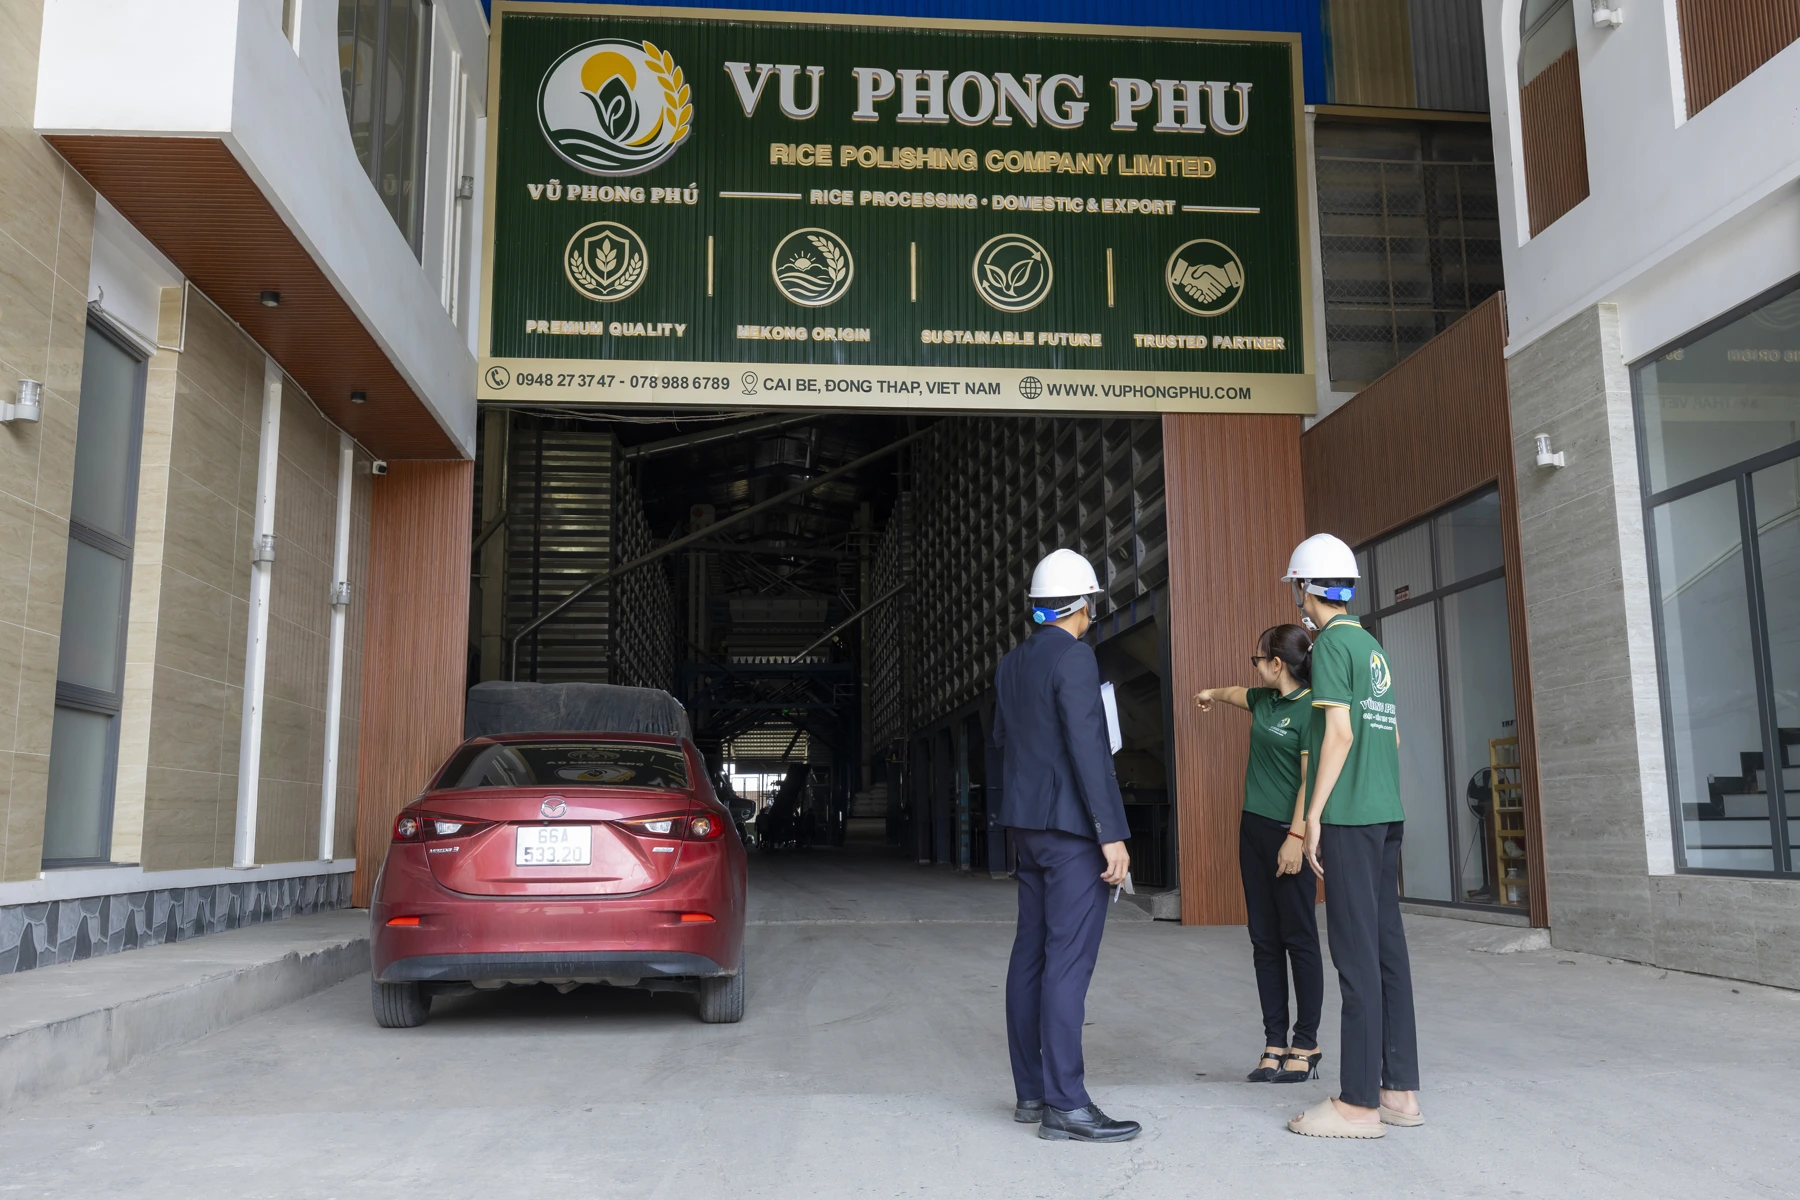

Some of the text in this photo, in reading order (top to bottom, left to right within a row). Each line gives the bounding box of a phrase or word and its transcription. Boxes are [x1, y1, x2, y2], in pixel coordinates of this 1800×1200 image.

[723, 61, 1253, 136] VU PHONG PHU
[770, 143, 1217, 178] RICE POLISHING COMPANY LIMITED
[527, 178, 699, 205] VŨ PHONG PHÚ
[810, 189, 1176, 215] RICE PROCESSING DOMESTIC & EXPORT
[525, 320, 688, 337] PREMIUM QUALITY
[736, 325, 871, 342] MEKONG ORIGIN
[920, 329, 1102, 347] SUSTAINABLE FUTURE
[1133, 333, 1285, 351] TRUSTED PARTNER
[516, 372, 553, 386] 0948
[630, 375, 658, 388] 078
[661, 376, 689, 389] 988
[692, 377, 730, 390] 6789
[763, 378, 1000, 396] CAI BE, ĐONG THAP, VIET NAM
[538, 828, 569, 844] 66A
[524, 846, 582, 863] 533.20
